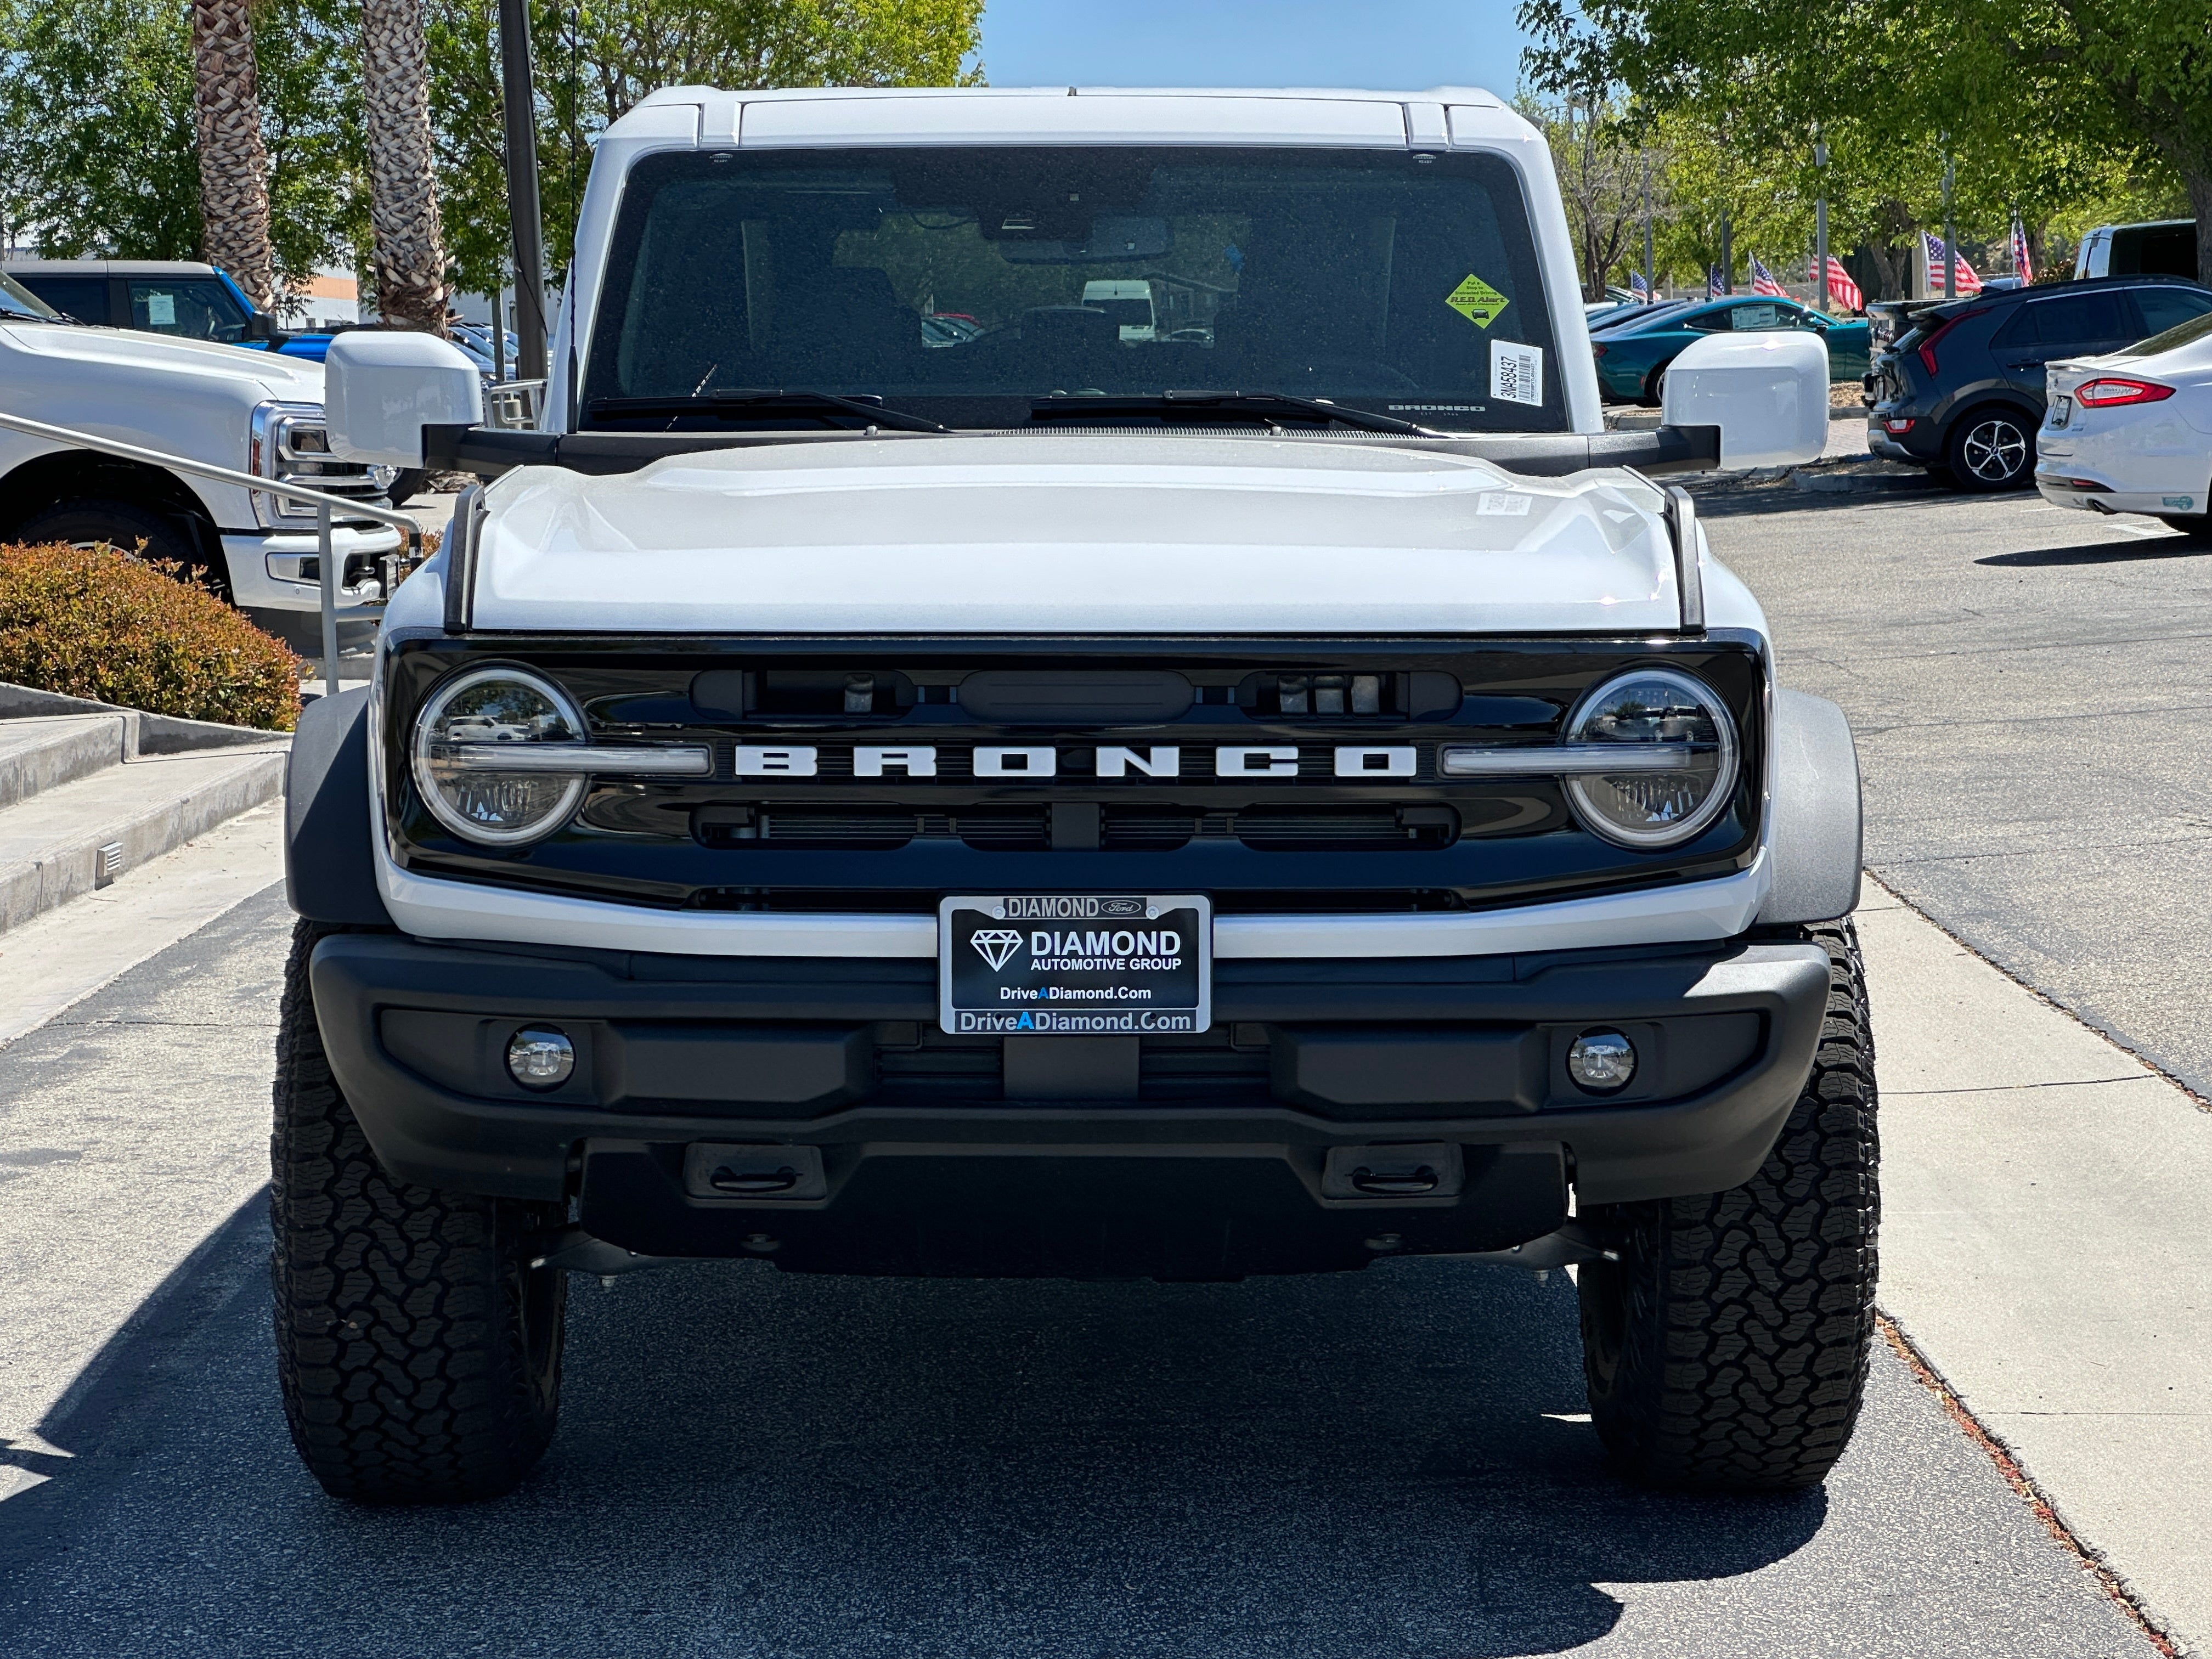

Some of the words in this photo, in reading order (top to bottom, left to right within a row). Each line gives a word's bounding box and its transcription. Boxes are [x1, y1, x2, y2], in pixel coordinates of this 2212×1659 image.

[1500, 356, 1517, 399] 3NA58437
[735, 745, 1418, 777] BRONCO
[1008, 898, 1099, 917] DIAMOND
[1108, 902, 1133, 912] Ford
[1030, 930, 1182, 956] DIAMOND
[1030, 958, 1126, 970] AUTOMOTIVE
[1129, 958, 1182, 970] GROUP
[1000, 986, 1152, 1000] DriveADiamond.Com
[960, 1012, 1190, 1030] DriveADiamond.Com
